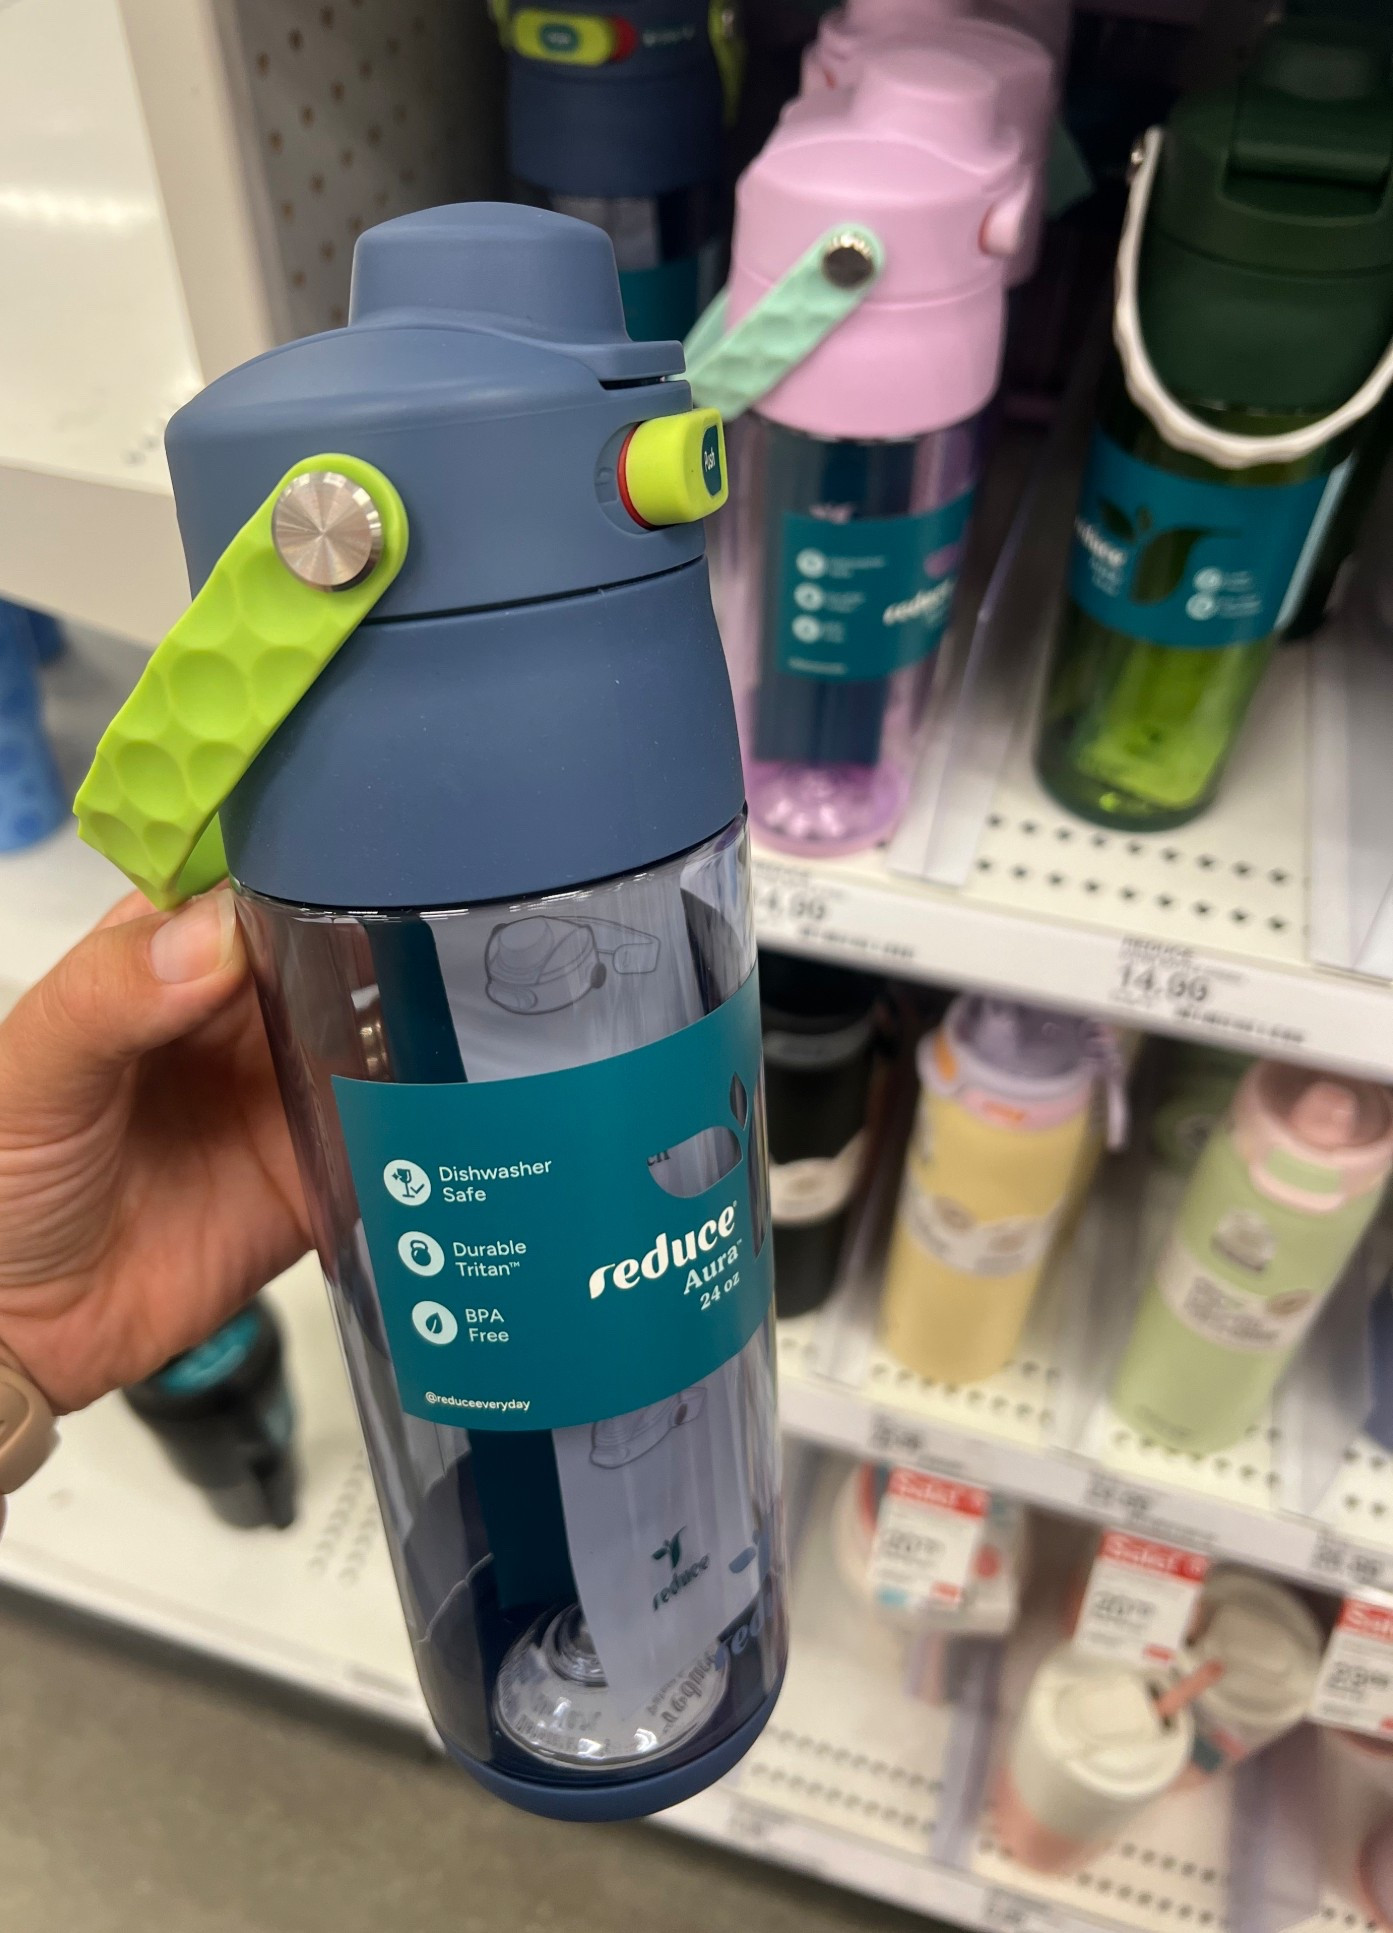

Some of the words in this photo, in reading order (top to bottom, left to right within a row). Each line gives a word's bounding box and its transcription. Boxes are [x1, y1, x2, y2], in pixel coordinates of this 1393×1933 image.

[704, 447, 716, 472] Push
[439, 1160, 552, 1182] Dishwasher
[443, 1186, 487, 1202] Safe
[453, 1240, 527, 1257] Durable
[455, 1261, 521, 1277] Tritan™
[700, 1285, 721, 1311] 24
[724, 1271, 740, 1293] oz
[465, 1308, 505, 1323] BPA
[469, 1328, 510, 1342] Free
[425, 1391, 531, 1412] @reduceeveryday
[653, 1553, 710, 1611] reduce
